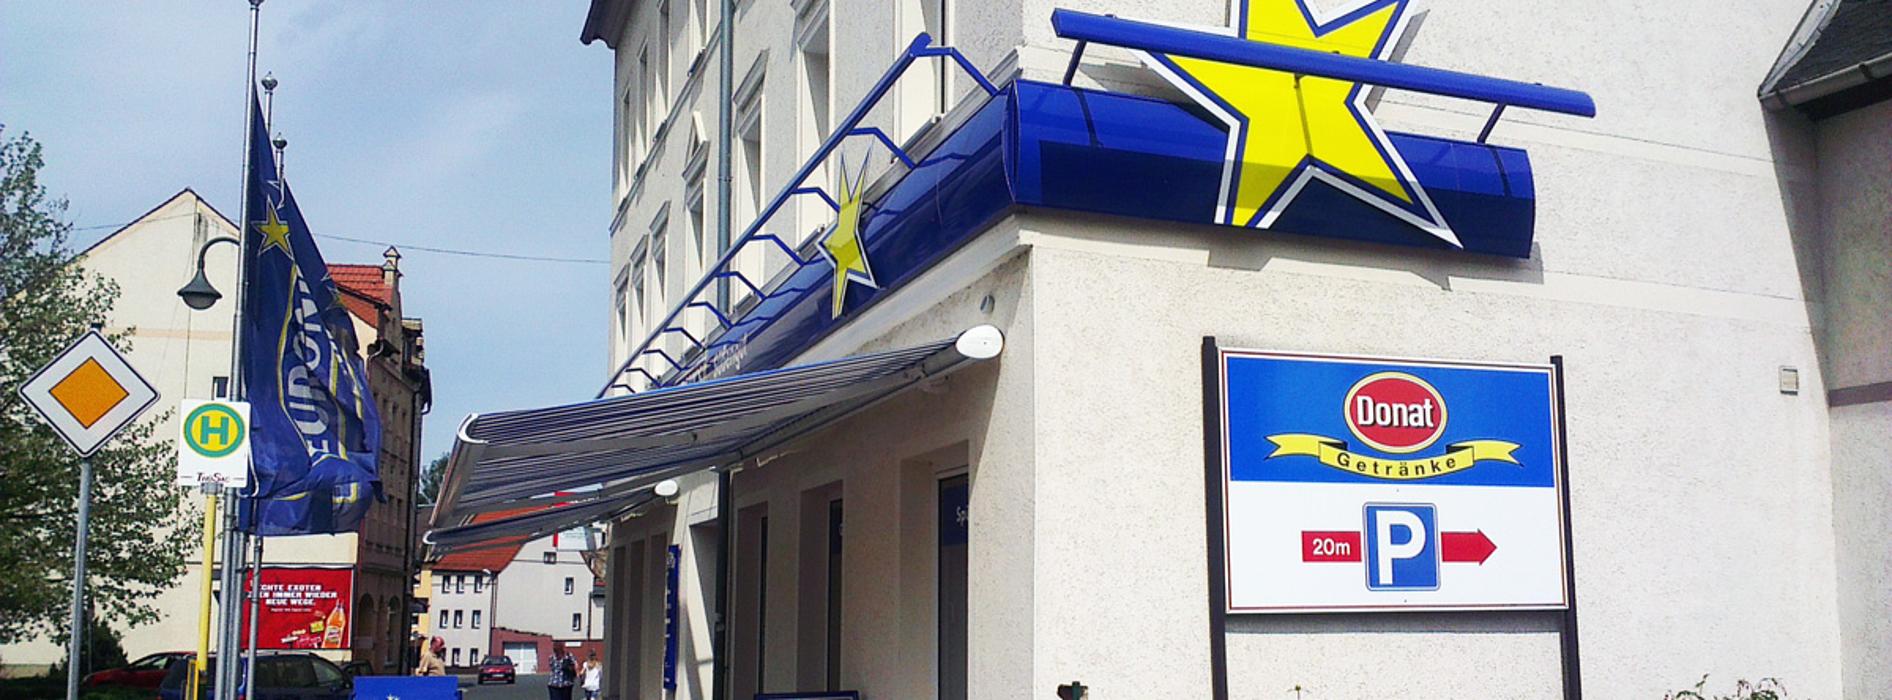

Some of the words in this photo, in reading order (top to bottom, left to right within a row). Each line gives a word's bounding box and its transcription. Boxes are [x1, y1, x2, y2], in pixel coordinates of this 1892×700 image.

[1356, 395, 1434, 428] Donat
[199, 415, 229, 446] H
[1337, 452, 1456, 477] Getränke
[1312, 538, 1351, 556] 20m
[1375, 509, 1427, 586] P
